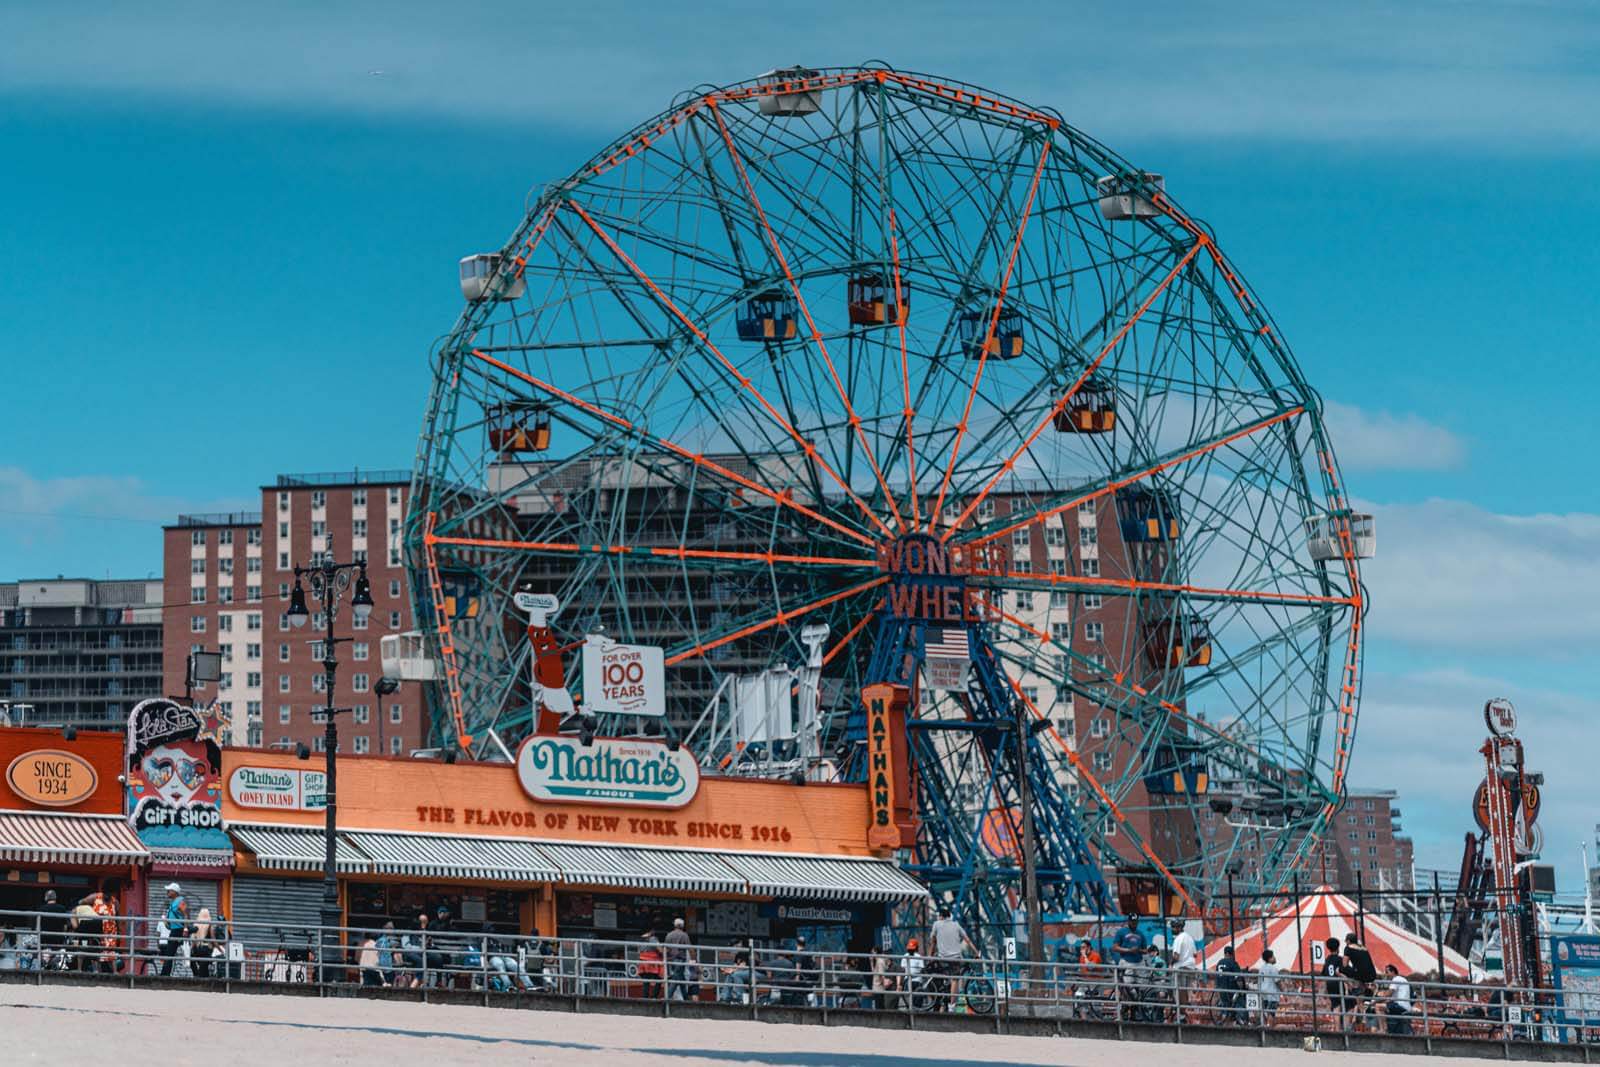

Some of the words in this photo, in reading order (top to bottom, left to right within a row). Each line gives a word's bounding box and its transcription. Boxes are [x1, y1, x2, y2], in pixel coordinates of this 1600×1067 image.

[875, 538, 1007, 576] WONDER
[888, 583, 1003, 622] WHEEL
[602, 655, 618, 663] FOR
[621, 652, 642, 661] OVER
[603, 662, 644, 687] 100
[603, 685, 645, 700] YEARS
[164, 706, 196, 731] Star
[34, 761, 72, 778] SINCE
[532, 740, 685, 787] Nathan's
[871, 698, 889, 827] NATHANS
[240, 769, 293, 786] Nathan's
[304, 774, 324, 783] GIFT
[38, 779, 68, 795] 1934
[304, 783, 324, 792] SHOP
[585, 789, 634, 798] FAMOUS
[240, 792, 264, 804] CONEY
[266, 793, 294, 806] ISLAND
[181, 810, 220, 826] SHOP
[416, 806, 455, 823] THE
[464, 809, 537, 828] FLAVOR
[544, 813, 569, 829] OF
[577, 814, 620, 833] NEW
[628, 818, 678, 836] YORK
[687, 822, 742, 839] SINCE
[751, 825, 791, 842] 1916
[1008, 942, 1014, 955] C
[1315, 945, 1322, 960] D
[1248, 999, 1257, 1007] 29
